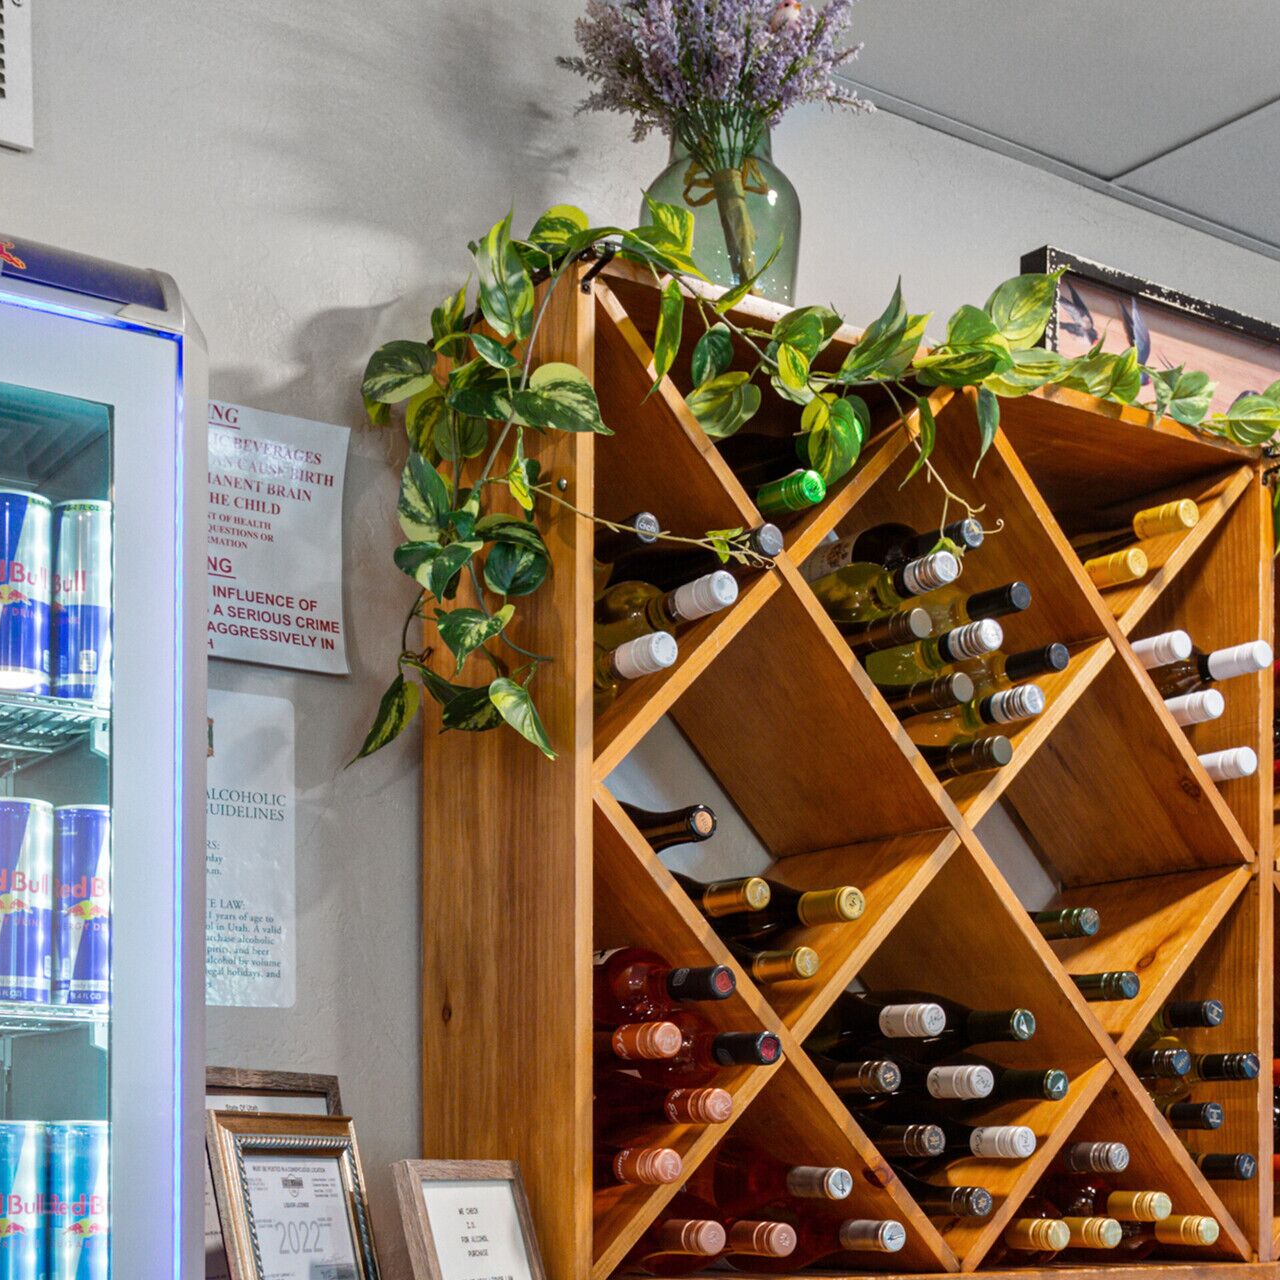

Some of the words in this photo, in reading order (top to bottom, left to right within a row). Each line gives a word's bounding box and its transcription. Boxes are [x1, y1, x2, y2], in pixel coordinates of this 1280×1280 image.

[234, 437, 322, 465] BEVERAGES
[234, 496, 281, 515] CHILD
[267, 483, 312, 502] BRAIN
[219, 514, 231, 523] OF
[234, 516, 271, 530] HEALTH
[260, 534, 274, 542] OR
[212, 585, 295, 609] INFLUENCE
[299, 599, 317, 611] OF
[214, 604, 223, 616] A
[227, 605, 291, 626] SERIOUS
[295, 616, 340, 633] CRIME
[208, 621, 318, 647] AGGRESSIVELY
[321, 639, 335, 650] IN
[207, 803, 284, 821] UIDELINES
[11, 871, 49, 897] Bull
[275, 1220, 324, 1254] 2022
